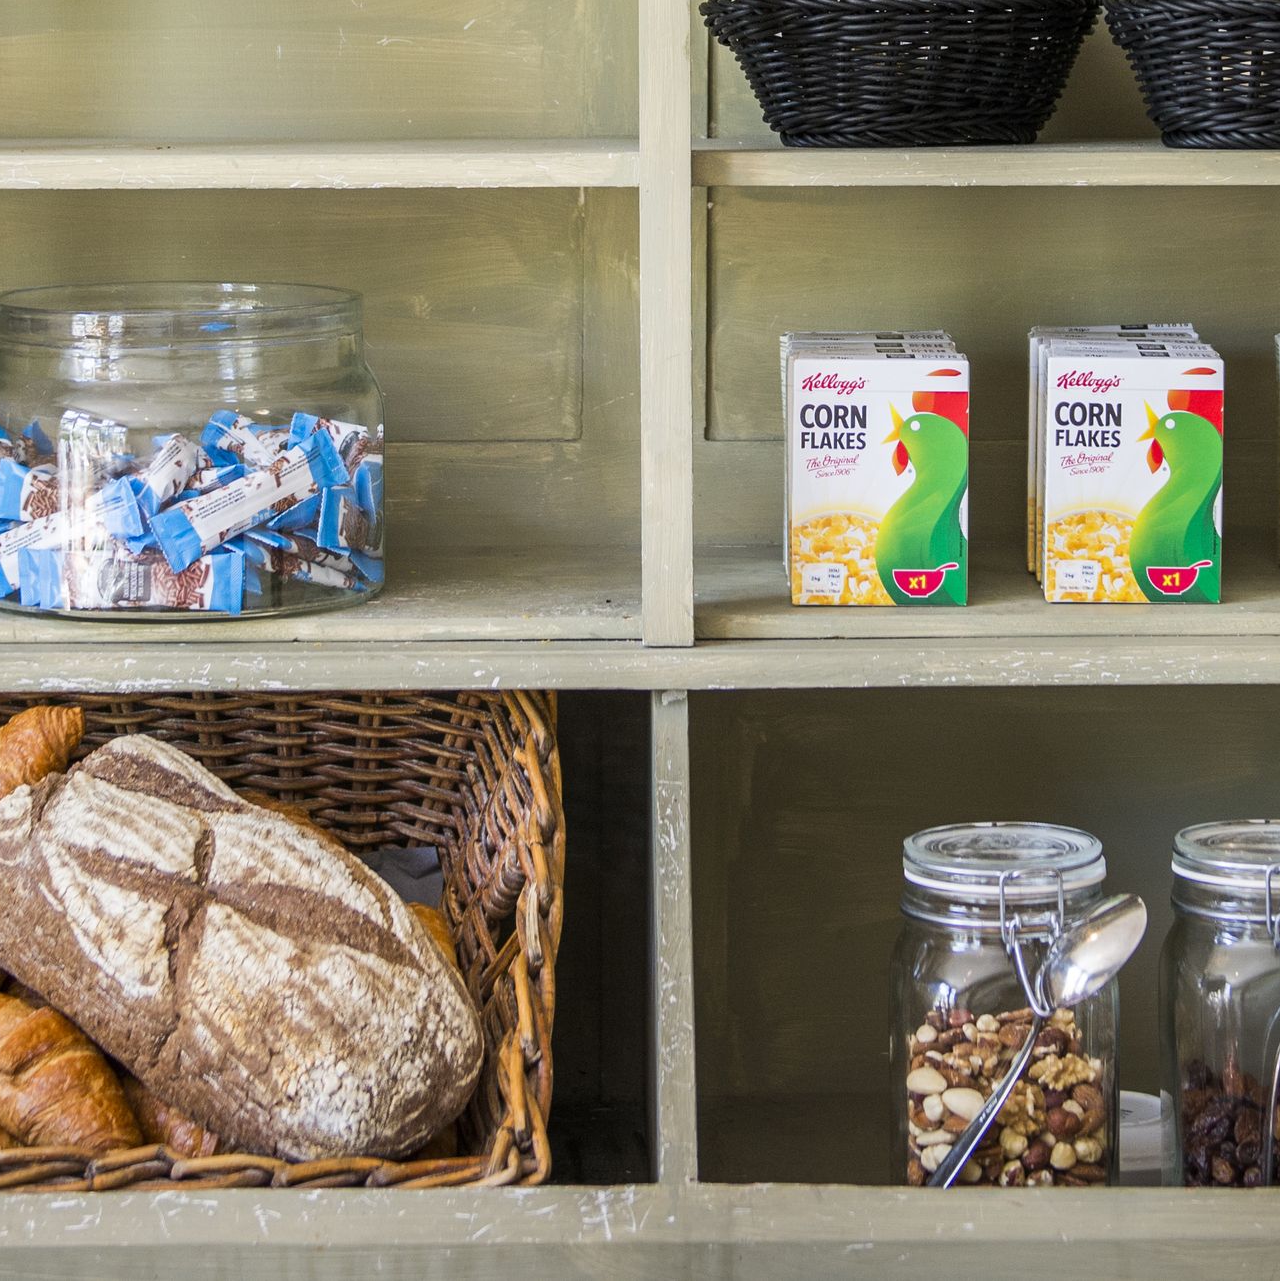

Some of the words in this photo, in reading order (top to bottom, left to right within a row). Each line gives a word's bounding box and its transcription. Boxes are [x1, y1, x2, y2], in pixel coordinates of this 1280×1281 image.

[802, 373, 867, 395] Kellogg's
[1057, 370, 1122, 393] Kellogg's
[800, 404, 867, 429] CORN
[1054, 401, 1122, 427] CORN
[801, 432, 866, 449] FLAKES
[1055, 429, 1121, 448] FLAKES
[806, 456, 822, 469] The
[822, 454, 859, 467] Original
[1061, 454, 1076, 467] The
[1077, 451, 1114, 466] Original
[909, 575, 927, 588] x1
[1163, 573, 1181, 586] x1
